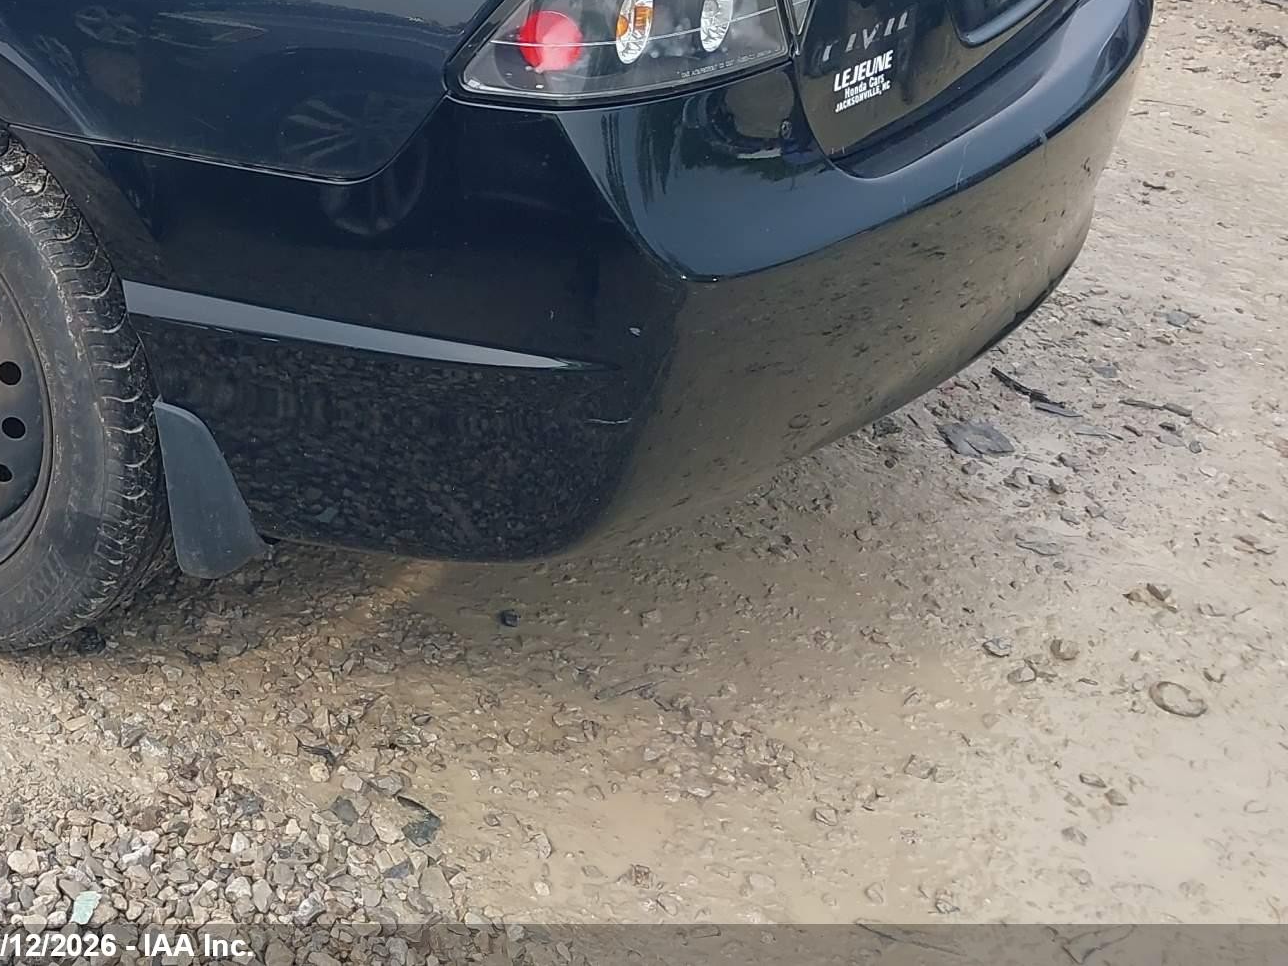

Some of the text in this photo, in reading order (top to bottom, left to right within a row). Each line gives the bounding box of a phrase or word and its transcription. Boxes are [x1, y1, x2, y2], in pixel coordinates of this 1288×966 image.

[833, 49, 894, 92] LEJEUNE
[844, 73, 886, 99] Honda Cars
